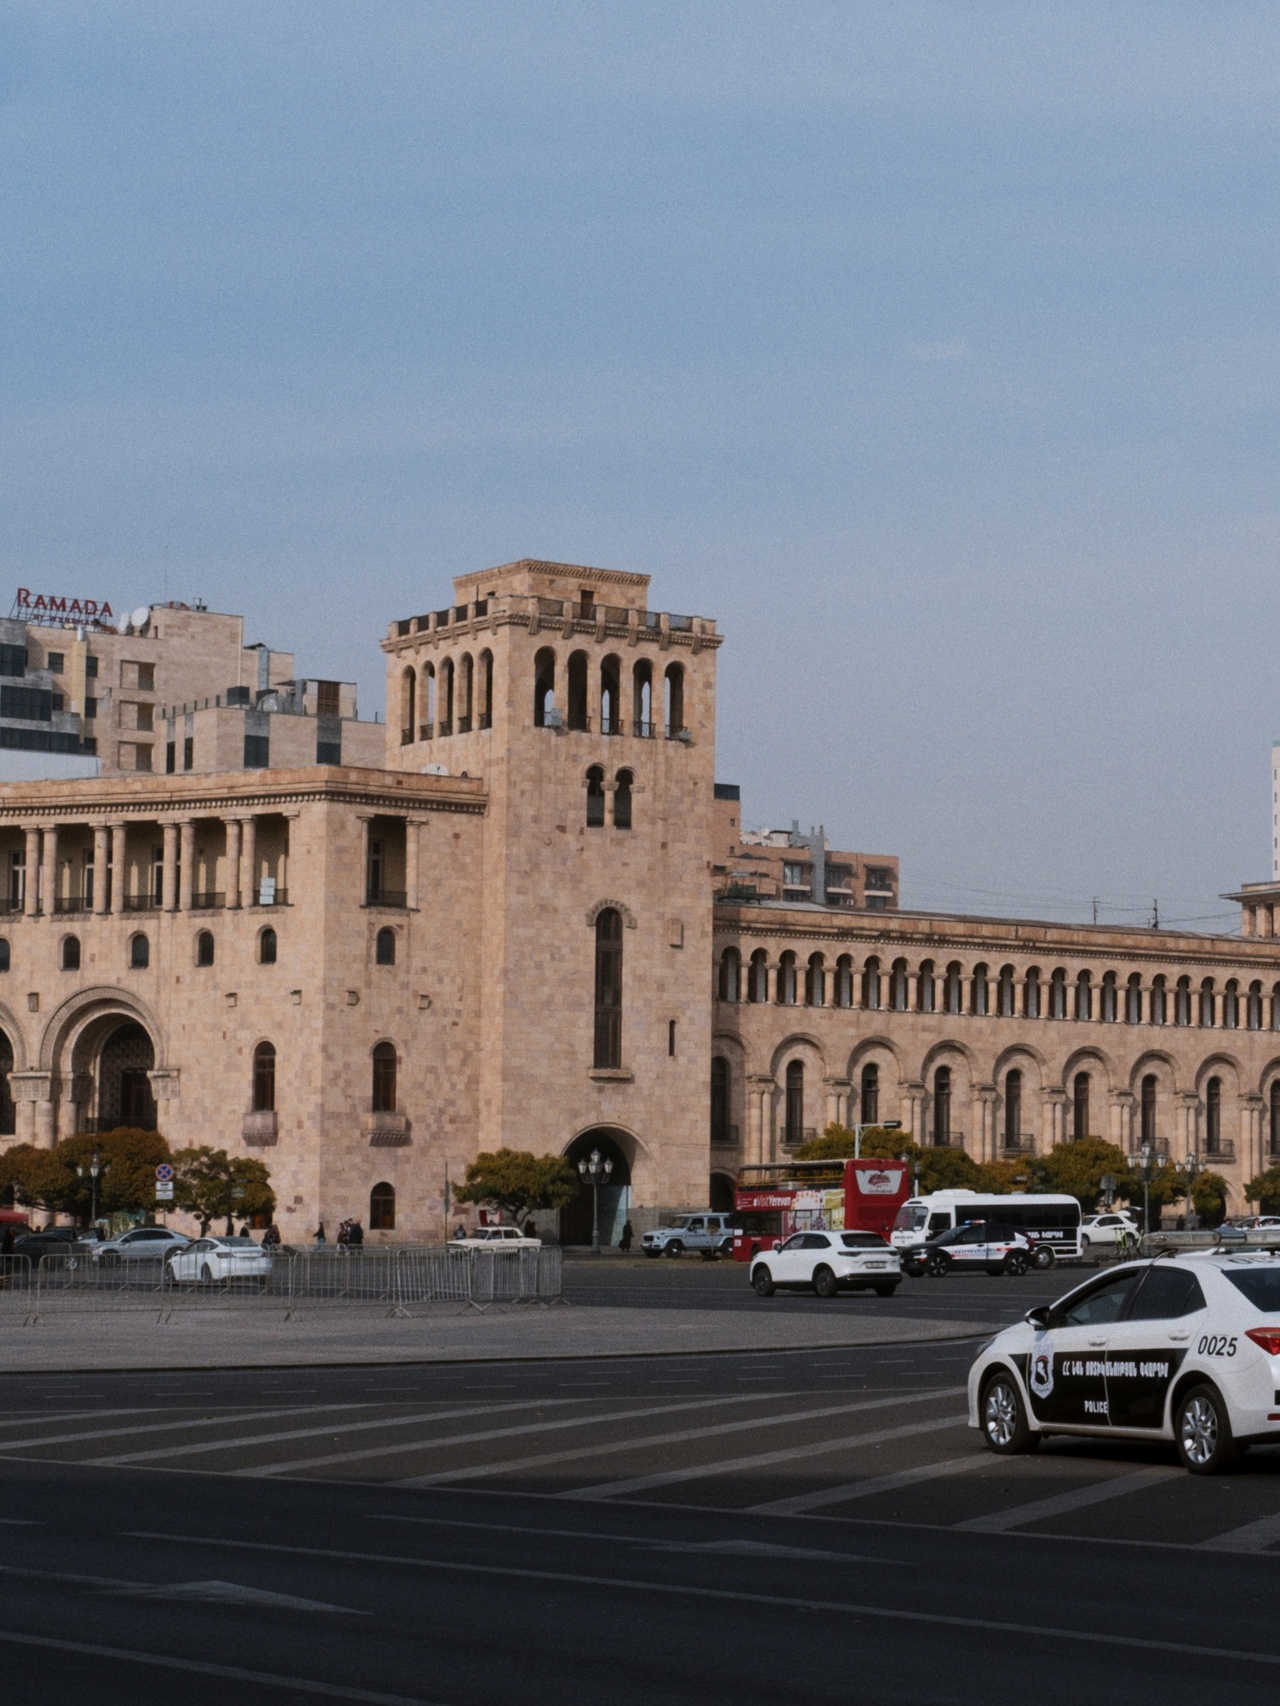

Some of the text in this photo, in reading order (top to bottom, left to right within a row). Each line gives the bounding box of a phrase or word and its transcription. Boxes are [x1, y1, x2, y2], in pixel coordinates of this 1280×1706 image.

[17, 588, 113, 617] RAMADA
[1198, 1335, 1238, 1357] 0025
[1084, 1400, 1108, 1413] POLICE
